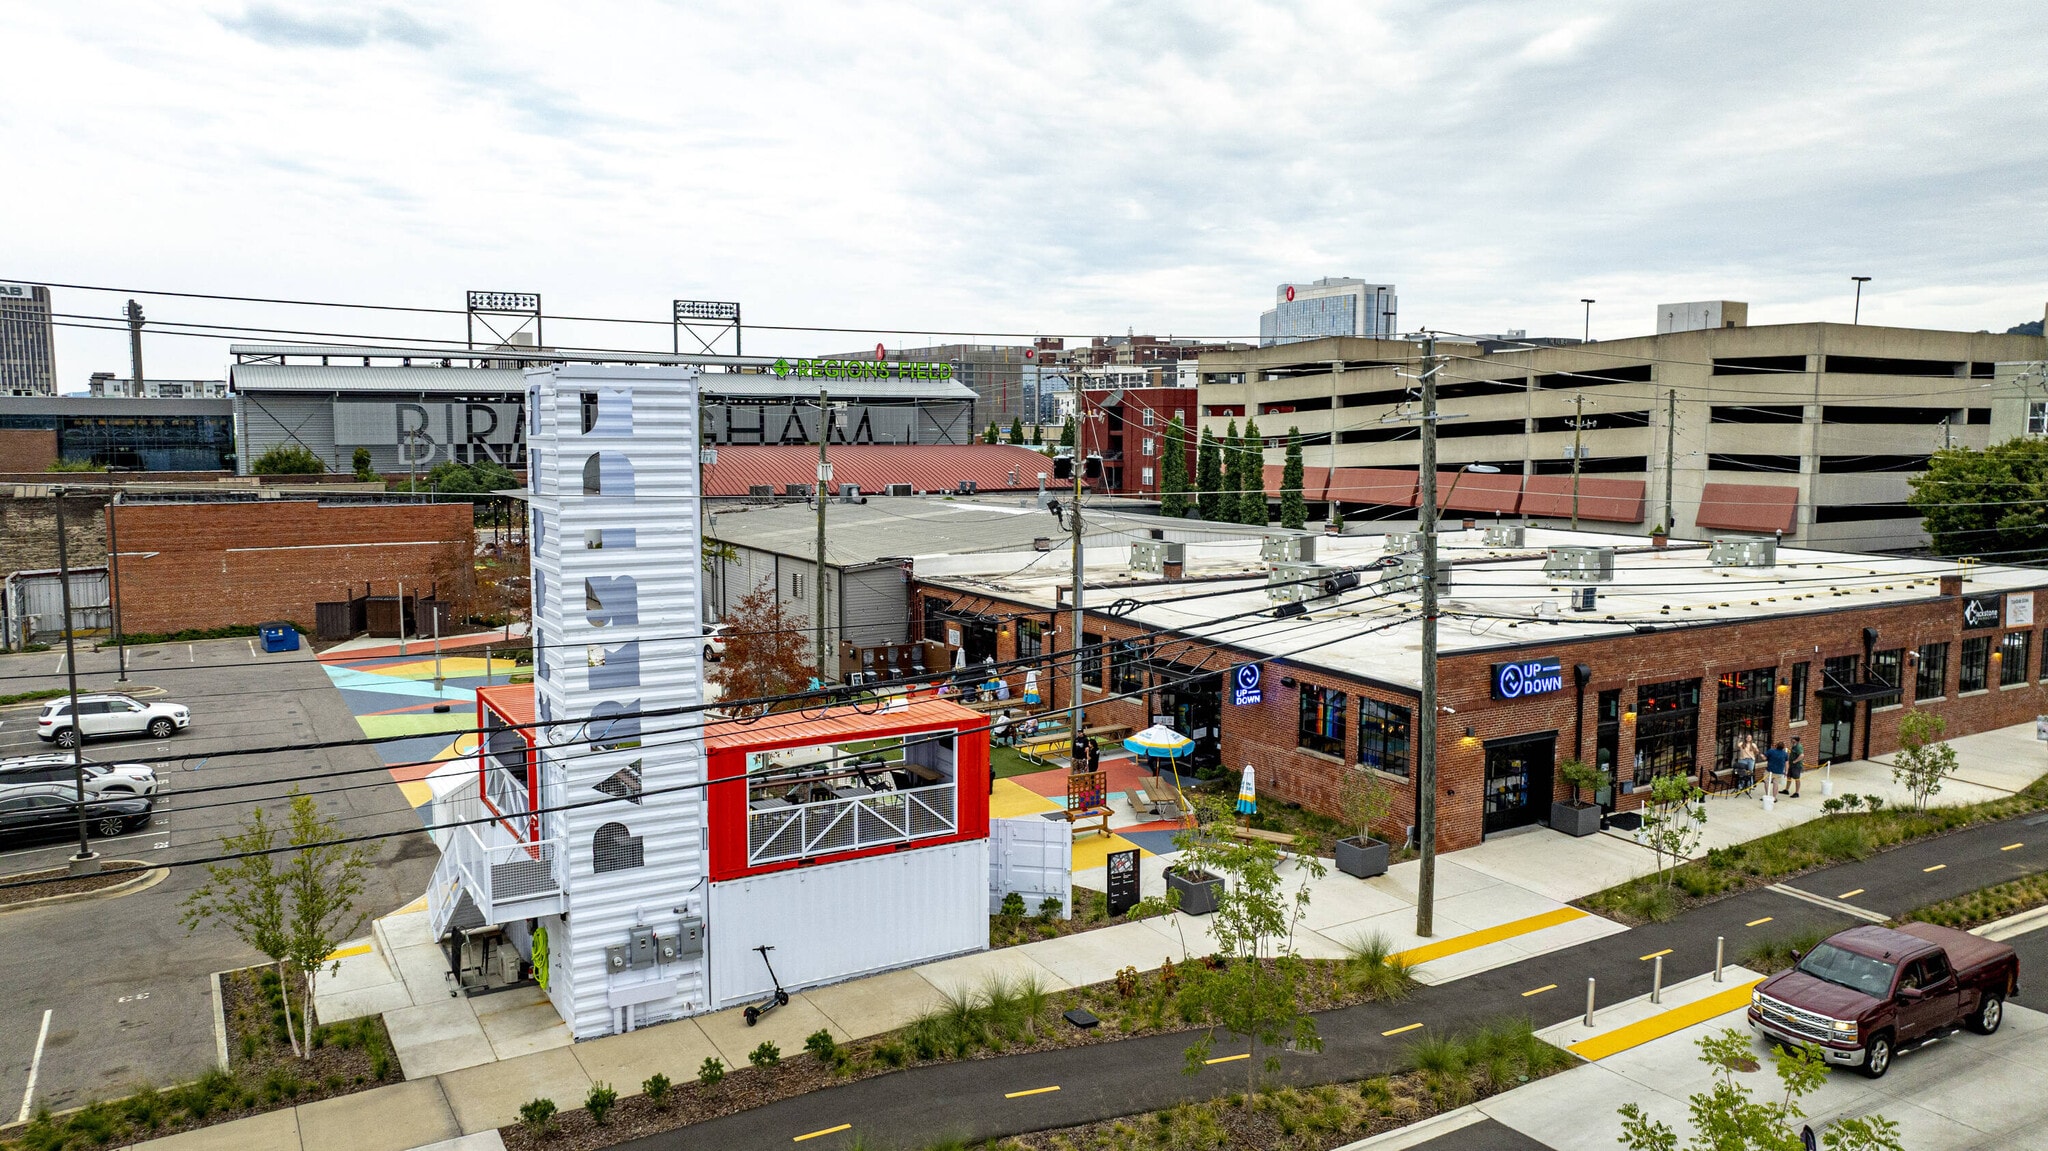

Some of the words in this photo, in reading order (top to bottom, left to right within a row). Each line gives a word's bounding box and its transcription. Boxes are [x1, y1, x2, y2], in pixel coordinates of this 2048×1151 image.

[797, 359, 890, 379] REGIONS
[898, 361, 953, 381] FIELD
[1523, 663, 1542, 678] UP
[1524, 676, 1562, 695] DOWN
[1236, 689, 1248, 698] UP
[1236, 695, 1261, 706] DOWN
